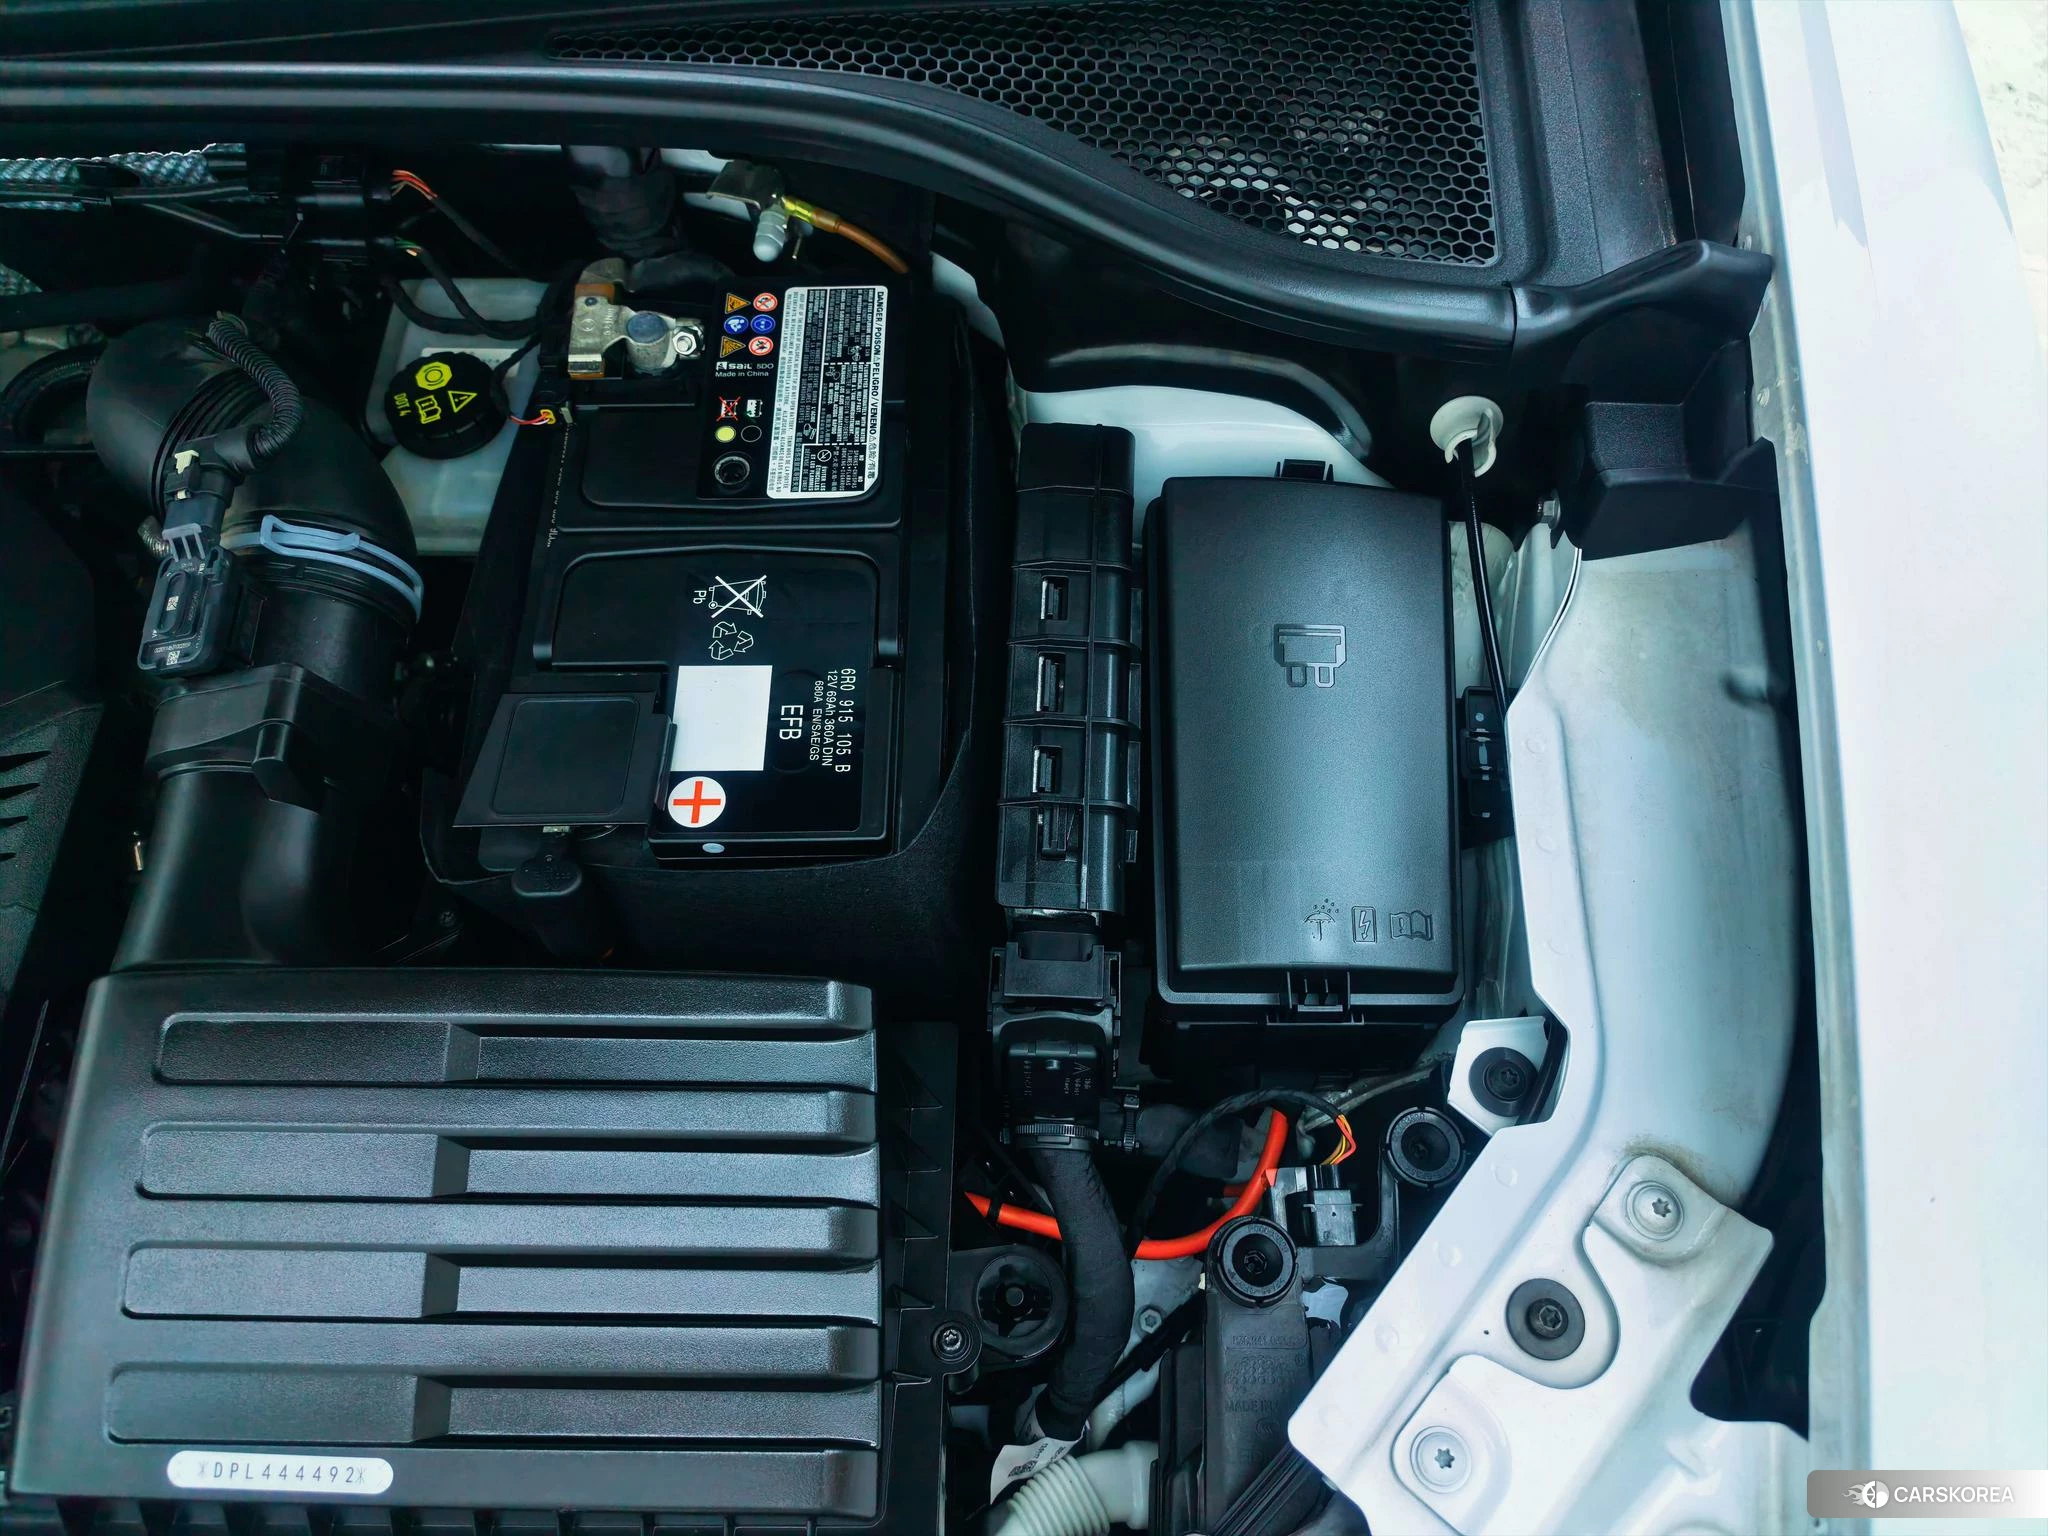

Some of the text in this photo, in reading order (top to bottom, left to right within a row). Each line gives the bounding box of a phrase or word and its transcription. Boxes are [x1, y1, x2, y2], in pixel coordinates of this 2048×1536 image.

[692, 590, 707, 604] Pb
[779, 705, 804, 740] EFB
[809, 680, 824, 761] 680A EN/SAE/GS
[822, 670, 838, 766] 12V 69Ah 360A DIN
[838, 700, 854, 723] 915
[836, 733, 852, 756] 105
[835, 764, 851, 773] B
